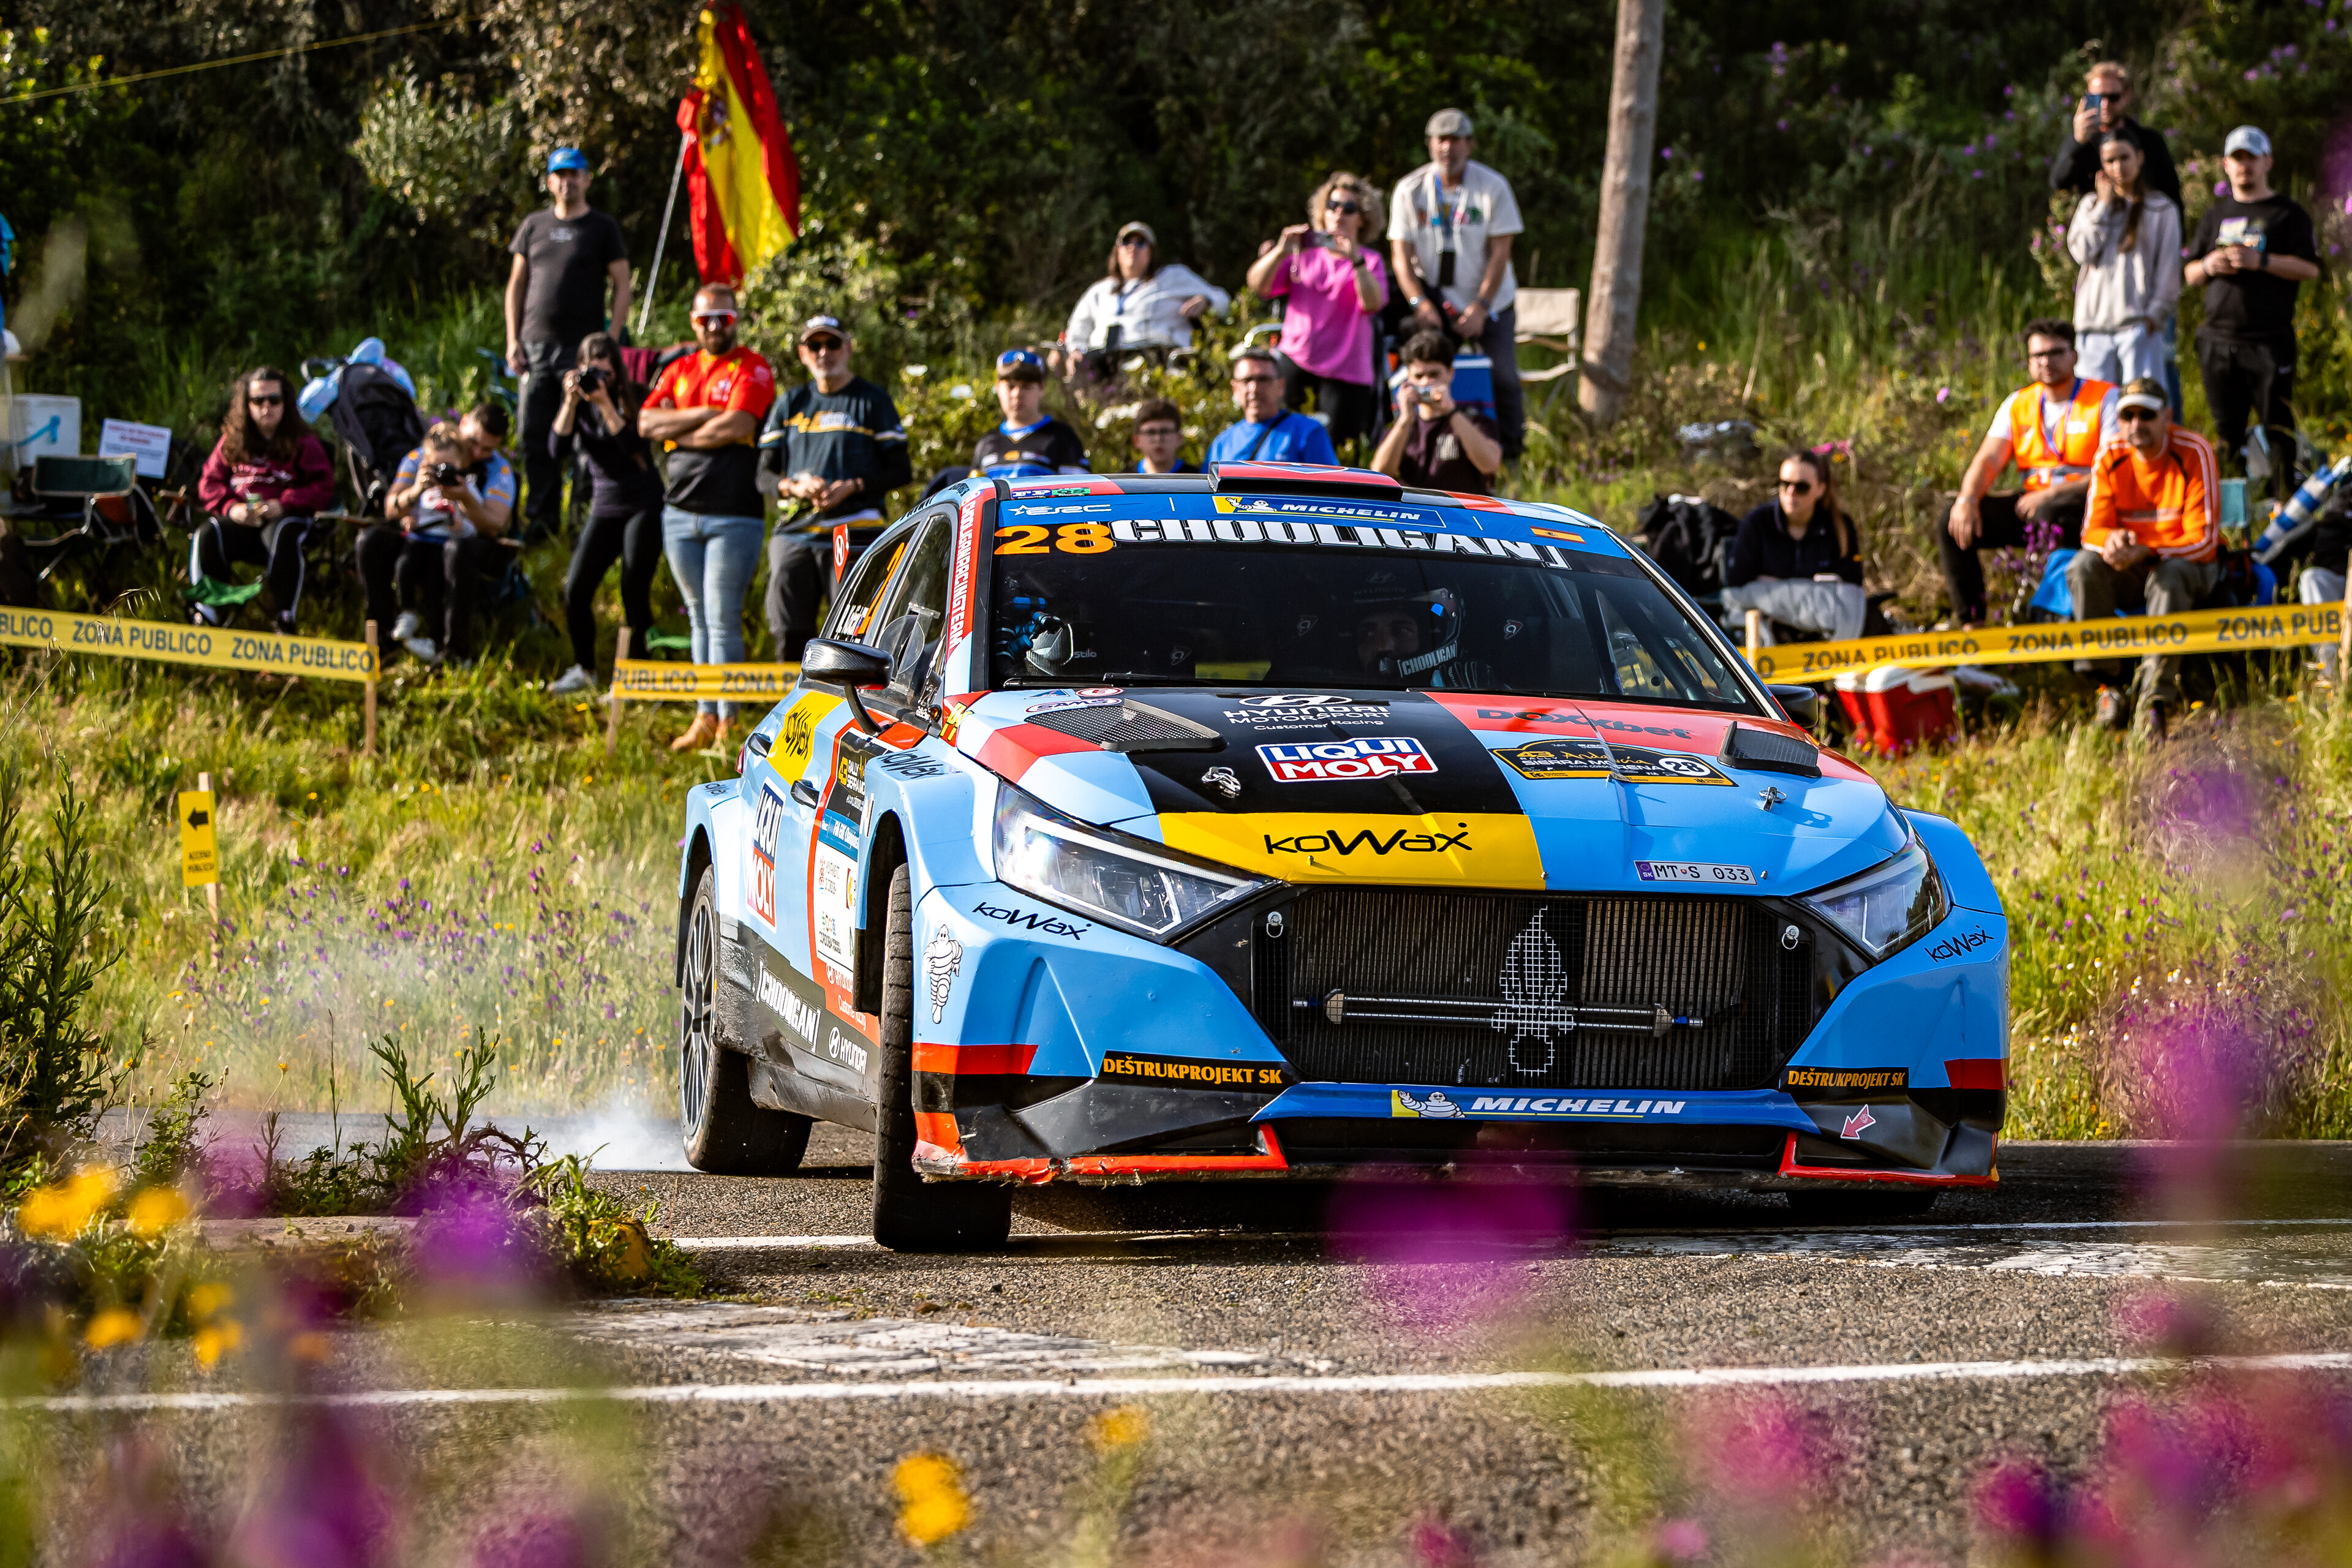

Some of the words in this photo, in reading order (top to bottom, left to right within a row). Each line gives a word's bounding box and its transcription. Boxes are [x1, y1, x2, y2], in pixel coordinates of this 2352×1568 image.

[1281, 503, 1420, 521] MICHELIN
[994, 523, 1114, 555] 28
[2216, 614, 2286, 643] ZONA
[72, 620, 124, 647] ZONA
[129, 626, 212, 655] PUBLICO
[231, 636, 284, 663] ZONA
[288, 643, 375, 673] PUBLICO
[1802, 649, 1867, 674] ZONA
[1874, 638, 1980, 663] PUBLICO
[2007, 631, 2074, 655] ZONA
[2081, 622, 2189, 650] PUBLICO
[720, 670, 777, 693] ZONA
[1223, 706, 1389, 718] HYUNDAI
[1228, 712, 1391, 724] MOTORSPORT
[1268, 740, 1414, 760] LIQUI
[1279, 755, 1422, 778] MOLY
[1665, 761, 1705, 772] 28
[753, 789, 782, 858] LIQUI
[1654, 865, 1678, 878] MT
[1687, 865, 1700, 879] S
[1713, 867, 1750, 881] 033
[1103, 1056, 1254, 1085] DEŠTRUKPROJEKT
[1259, 1069, 1283, 1084] SK
[1787, 1068, 1891, 1090] DEŠTRUKPROJEKT
[1890, 1072, 1906, 1086] SK
[1471, 1097, 1686, 1114] MICHELIN
